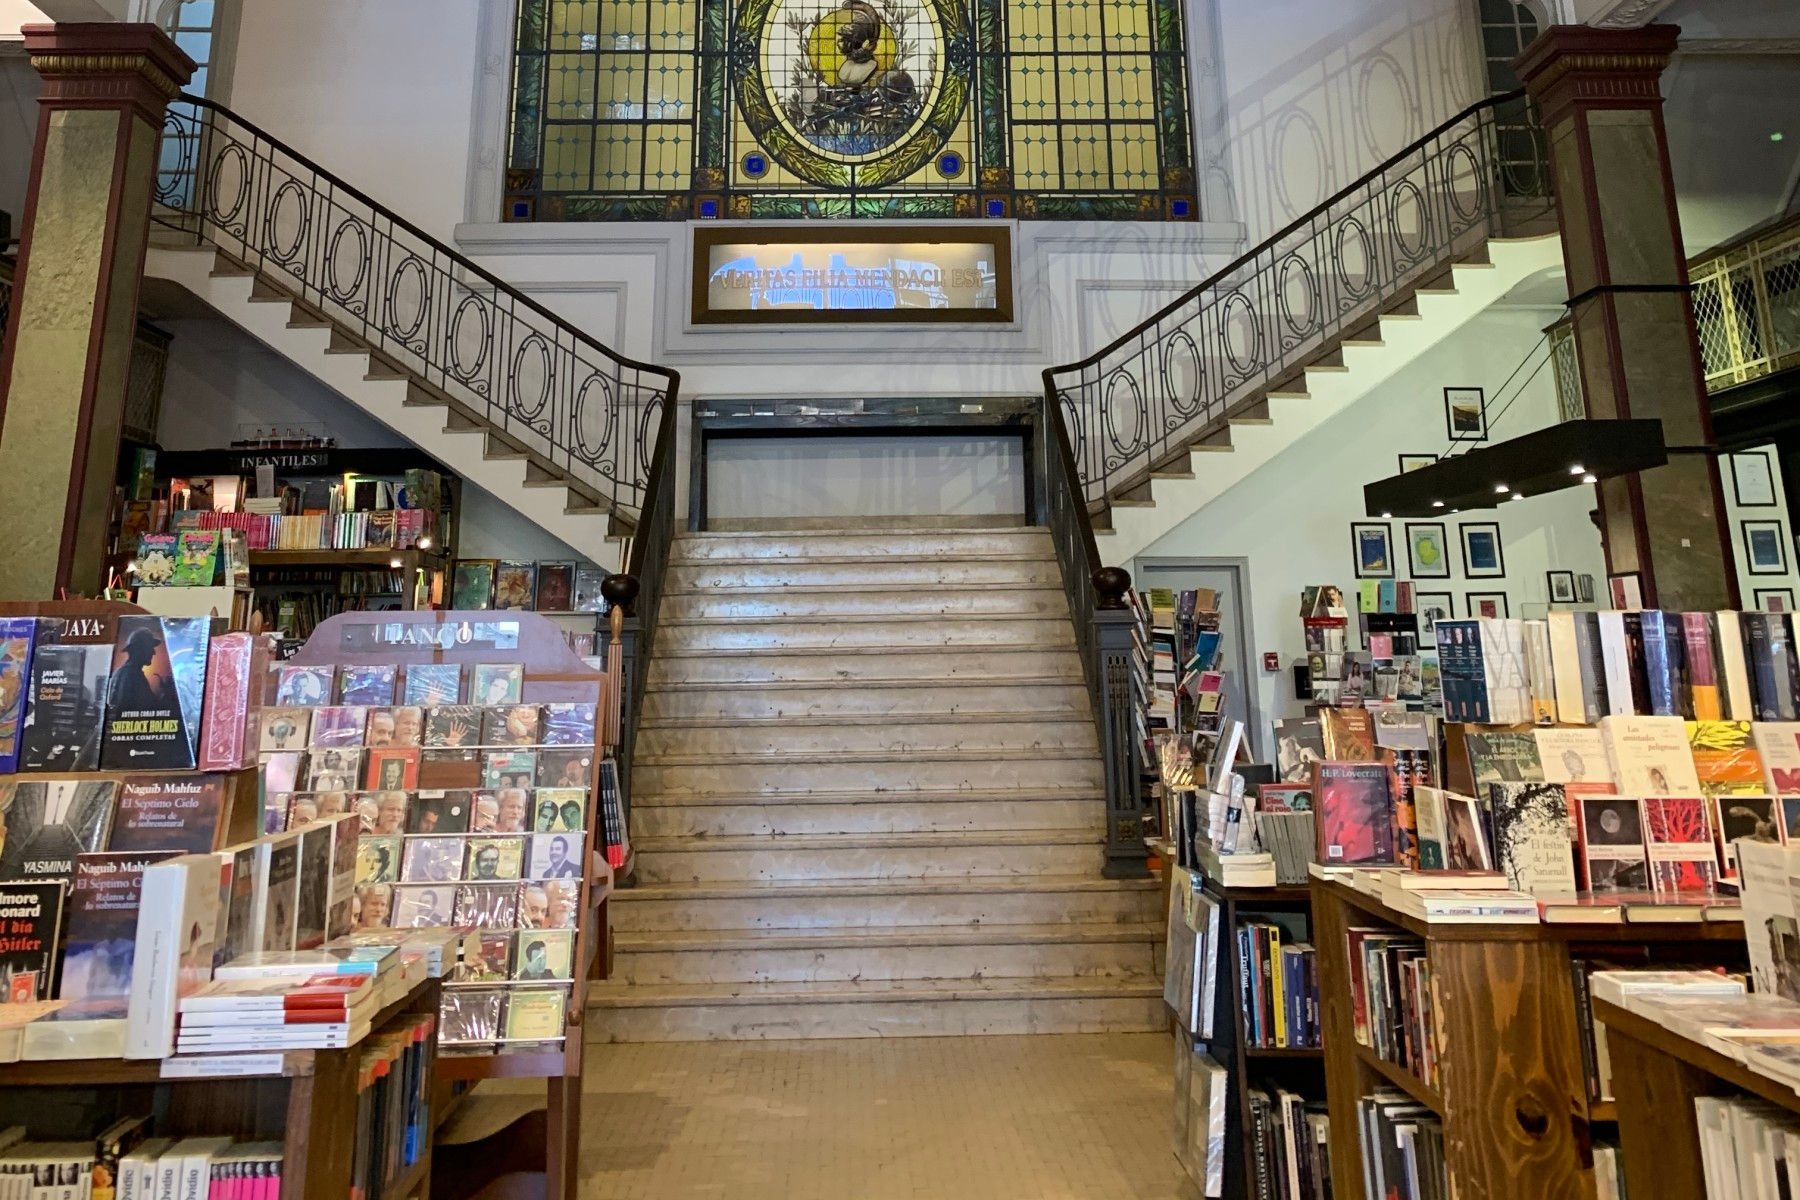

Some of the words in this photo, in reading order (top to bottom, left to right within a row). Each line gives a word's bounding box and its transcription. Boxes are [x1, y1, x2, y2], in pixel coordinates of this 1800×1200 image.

[719, 268, 797, 289] VERITAS
[801, 268, 849, 289] FILIA
[951, 268, 986, 288] EST
[241, 453, 317, 468] INFANTILES
[391, 625, 473, 645] TANGO
[42, 670, 65, 678] JAVIER
[112, 720, 149, 734] SHERLOCK
[149, 719, 178, 733] HOLMES
[1342, 768, 1383, 778] Lovecraft
[125, 783, 161, 797] Naguib
[164, 783, 202, 794] Mahfuz
[121, 798, 132, 808] El
[139, 812, 166, 820] Relatos
[168, 811, 177, 820] de
[138, 819, 184, 828] sobrenatural
[23, 861, 72, 873] YASMINA
[79, 863, 117, 876] Naguib
[120, 861, 149, 873] Mah
[77, 879, 87, 889] El
[0, 892, 38, 905] lmore
[96, 893, 124, 901] Relatos
[126, 891, 136, 901] de
[0, 904, 41, 918] onard
[95, 901, 140, 910] sobrenatur
